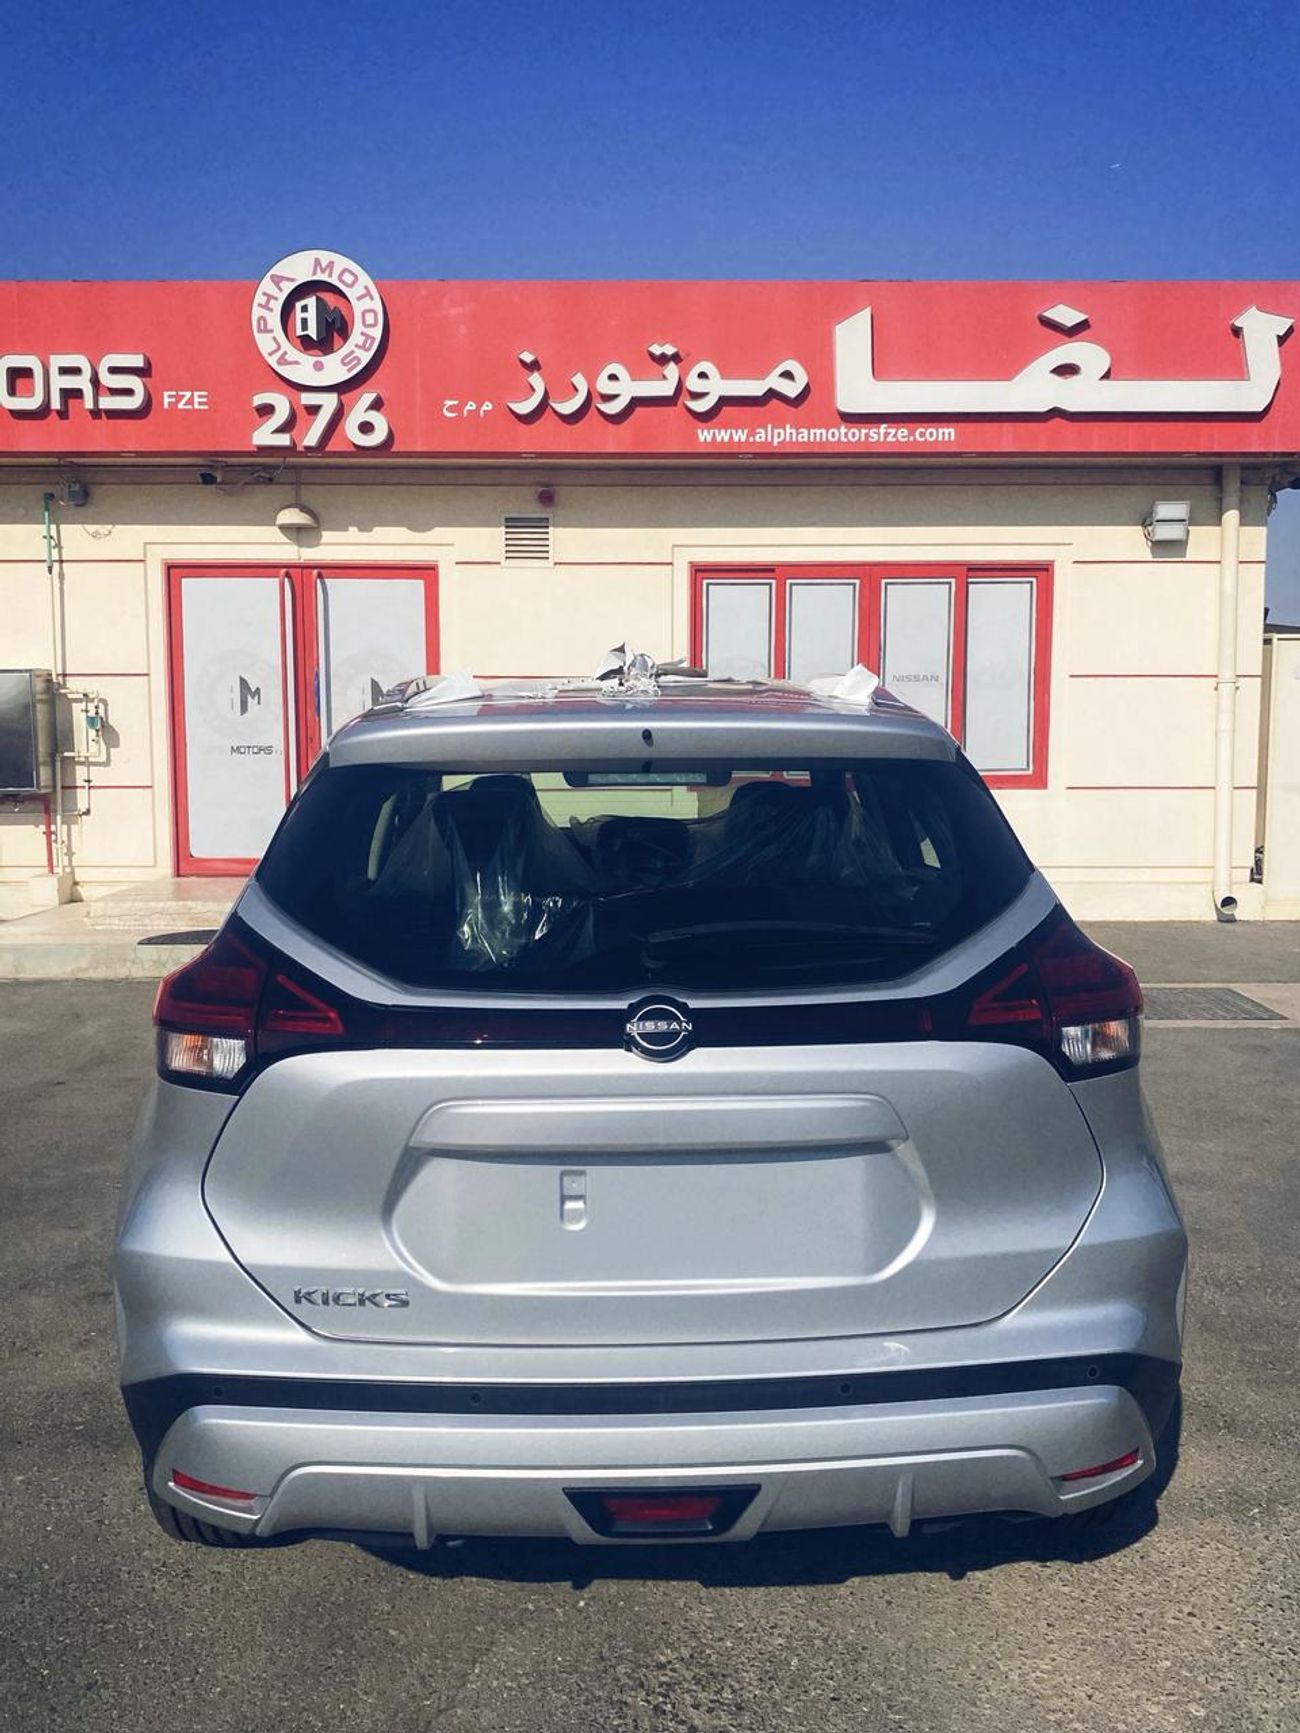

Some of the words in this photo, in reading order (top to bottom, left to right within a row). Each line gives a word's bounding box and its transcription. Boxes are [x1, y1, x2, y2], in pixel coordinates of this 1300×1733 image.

[256, 272, 302, 367] ALPHA
[311, 257, 379, 373] MOTORS
[0, 353, 148, 411] ORS
[162, 391, 209, 409] FZE
[506, 342, 810, 415] موتورز
[251, 391, 390, 448] 276
[697, 424, 956, 446] www.alphamotorsfze.com
[892, 674, 940, 682] NISSAN
[230, 745, 273, 755] MOTORS
[626, 1021, 693, 1032] NISSAN
[293, 1287, 410, 1308] KICKS
